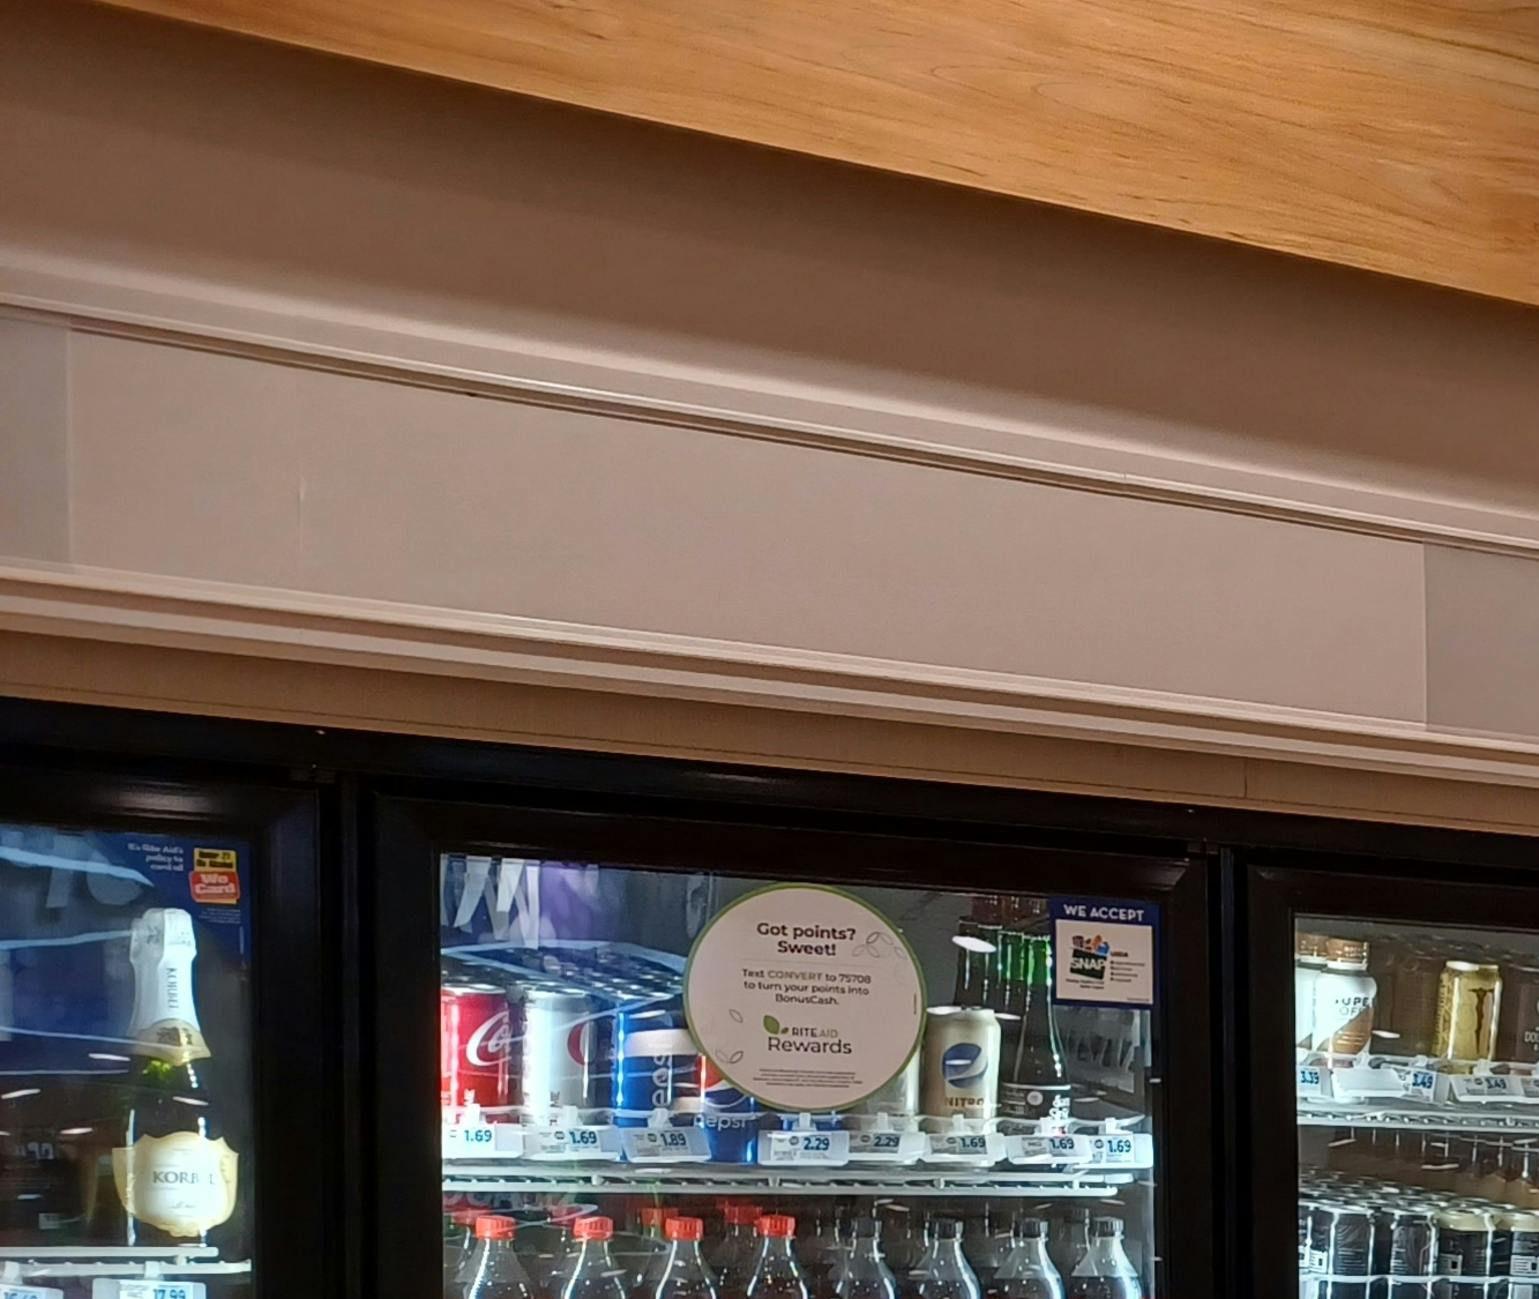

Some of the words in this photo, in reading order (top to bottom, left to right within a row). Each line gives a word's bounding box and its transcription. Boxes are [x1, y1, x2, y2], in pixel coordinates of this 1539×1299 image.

[200, 873, 229, 884] We
[195, 883, 236, 894] Card
[1063, 904, 1086, 917] WE
[1090, 907, 1144, 921] ACCEPT
[757, 923, 788, 936] Got
[793, 925, 856, 940] points?
[777, 941, 836, 956] Sweet!
[1071, 959, 1105, 970] SNAP
[742, 969, 764, 978] Text
[768, 971, 822, 980] CONVERT
[825, 973, 836, 982] to
[838, 975, 871, 984] 75708
[744, 981, 755, 989] to
[759, 982, 781, 991] turn
[784, 984, 808, 993] your
[812, 984, 845, 994] points
[848, 986, 869, 995] into
[775, 994, 839, 1005] BonusCash.
[768, 1037, 852, 1054] Rewards
[463, 1129, 492, 1142] 1.69
[569, 1131, 597, 1144] 1.69
[660, 1133, 686, 1146] 1.89
[874, 1135, 899, 1148] 2.29
[803, 1137, 829, 1150] 2.29
[961, 1136, 986, 1149] 1.69
[1051, 1138, 1074, 1149] 1.69
[1108, 1140, 1131, 1152] 1.69
